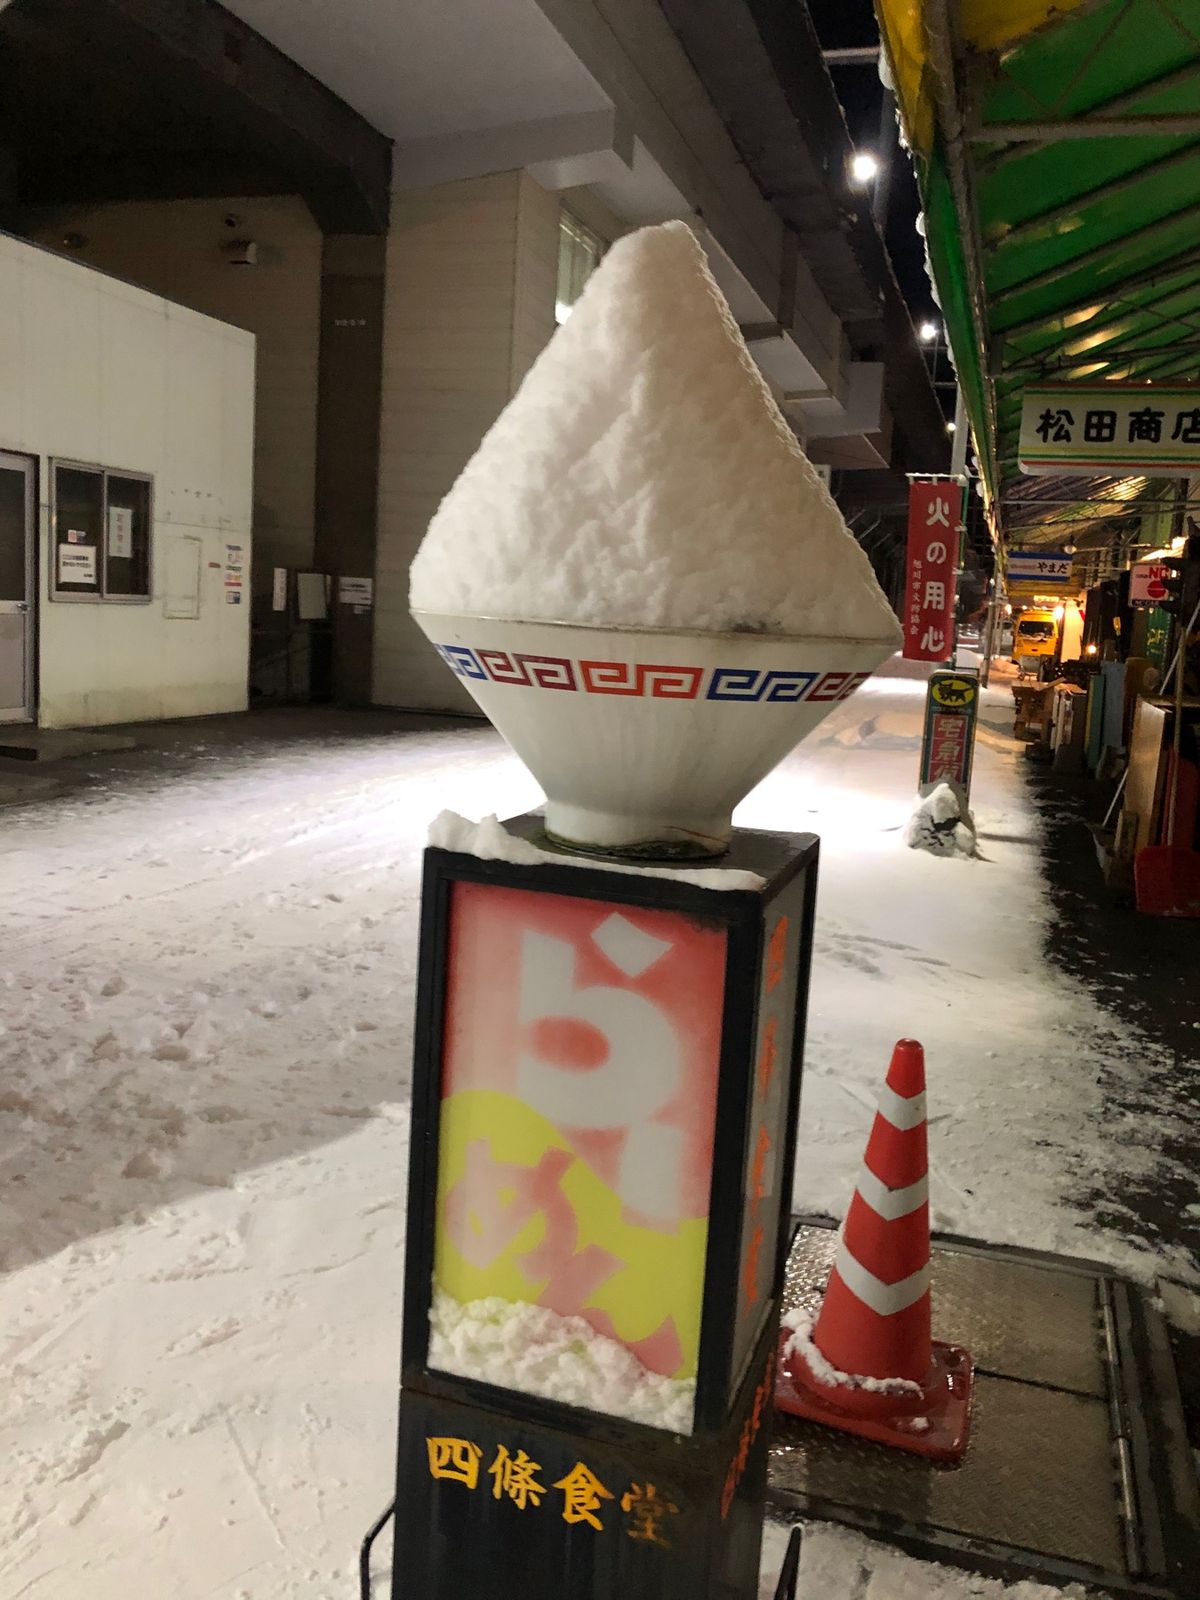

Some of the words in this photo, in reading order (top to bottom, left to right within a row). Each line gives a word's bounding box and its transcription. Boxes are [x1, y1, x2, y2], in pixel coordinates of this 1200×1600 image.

[1035, 407, 1200, 443] 松田商店
[920, 497, 950, 652] 火の用心
[1037, 562, 1070, 574] やまだ
[426, 1436, 679, 1549] 四條食堂
